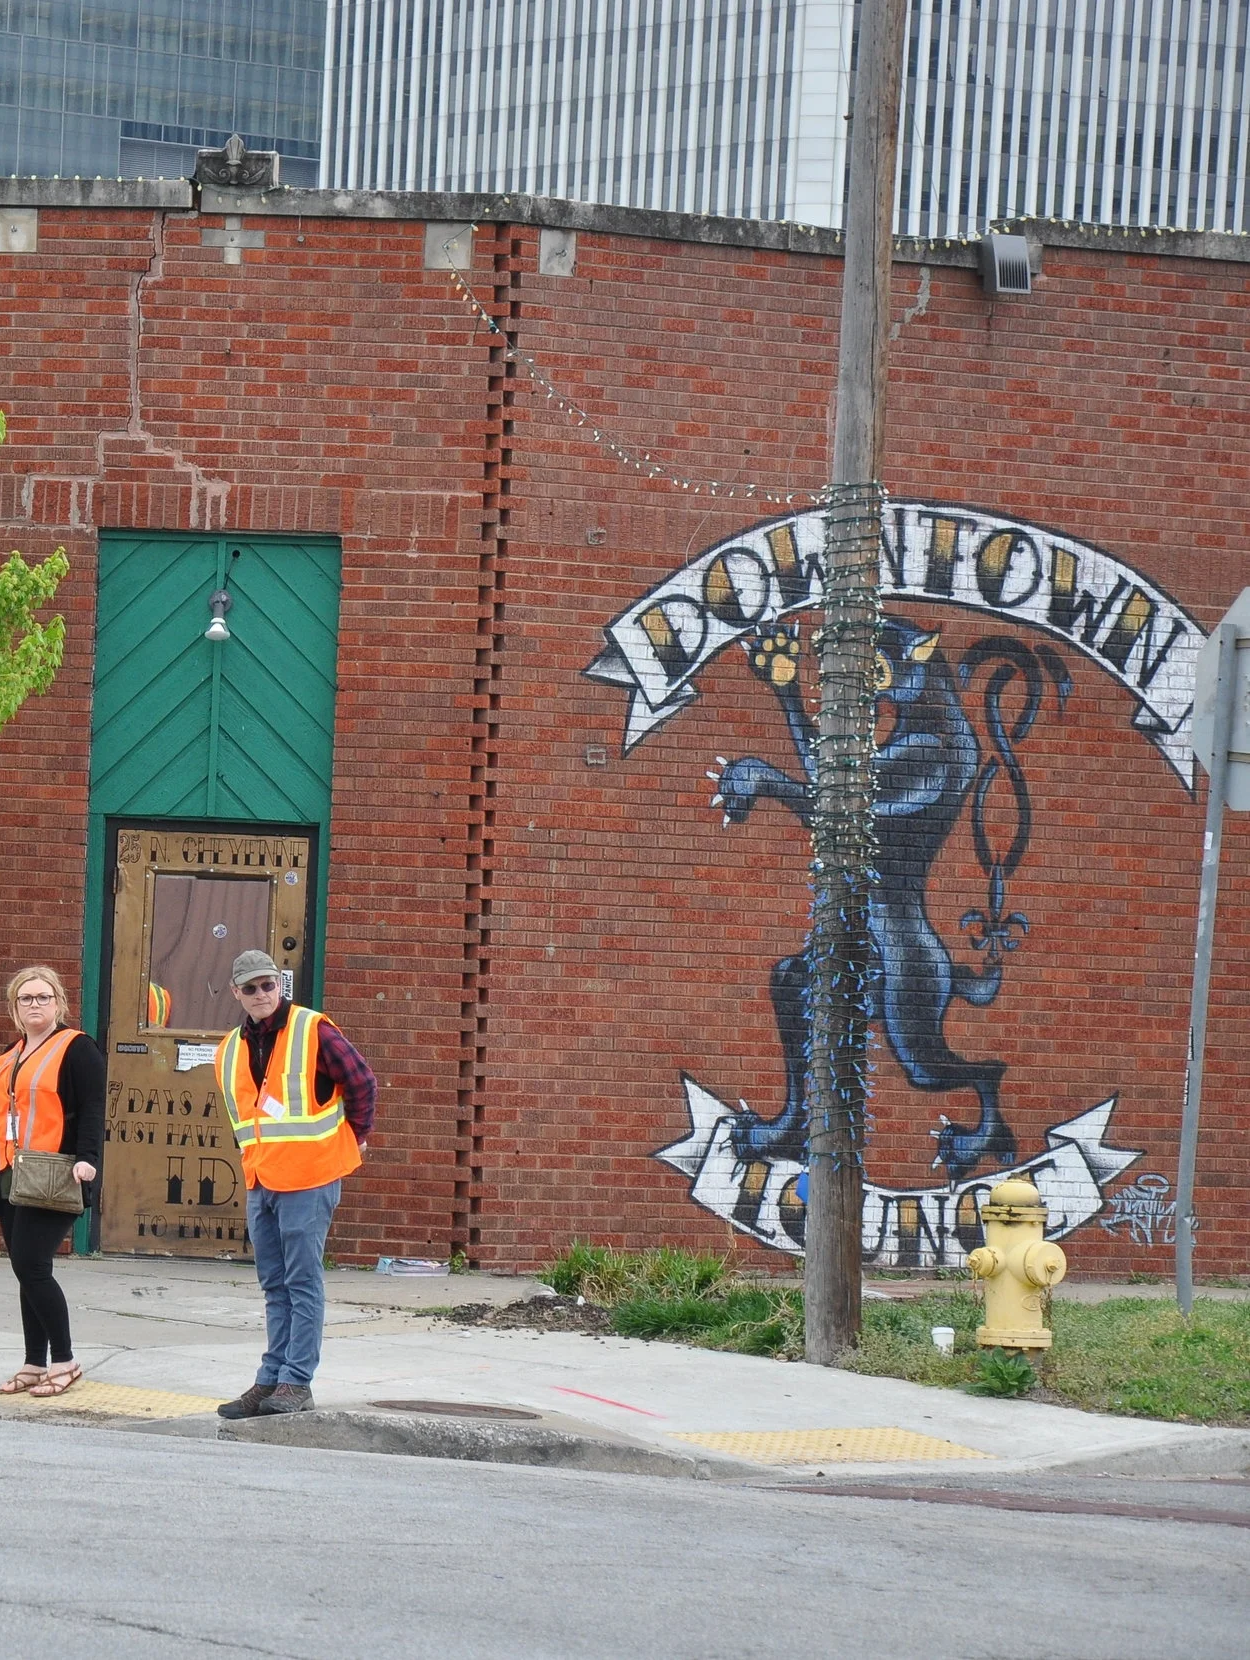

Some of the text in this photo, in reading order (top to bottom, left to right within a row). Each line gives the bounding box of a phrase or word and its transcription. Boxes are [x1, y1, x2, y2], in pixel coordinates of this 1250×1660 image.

[118, 833, 307, 868] 25 N. CHEYENNE
[282, 972, 292, 999] PANIC!
[108, 1081, 219, 1118] 7 DAYS A
[104, 1119, 158, 1144] MUST
[166, 1123, 223, 1148] HAVE
[165, 1155, 239, 1208] I.D.
[134, 1213, 168, 1237] TO
